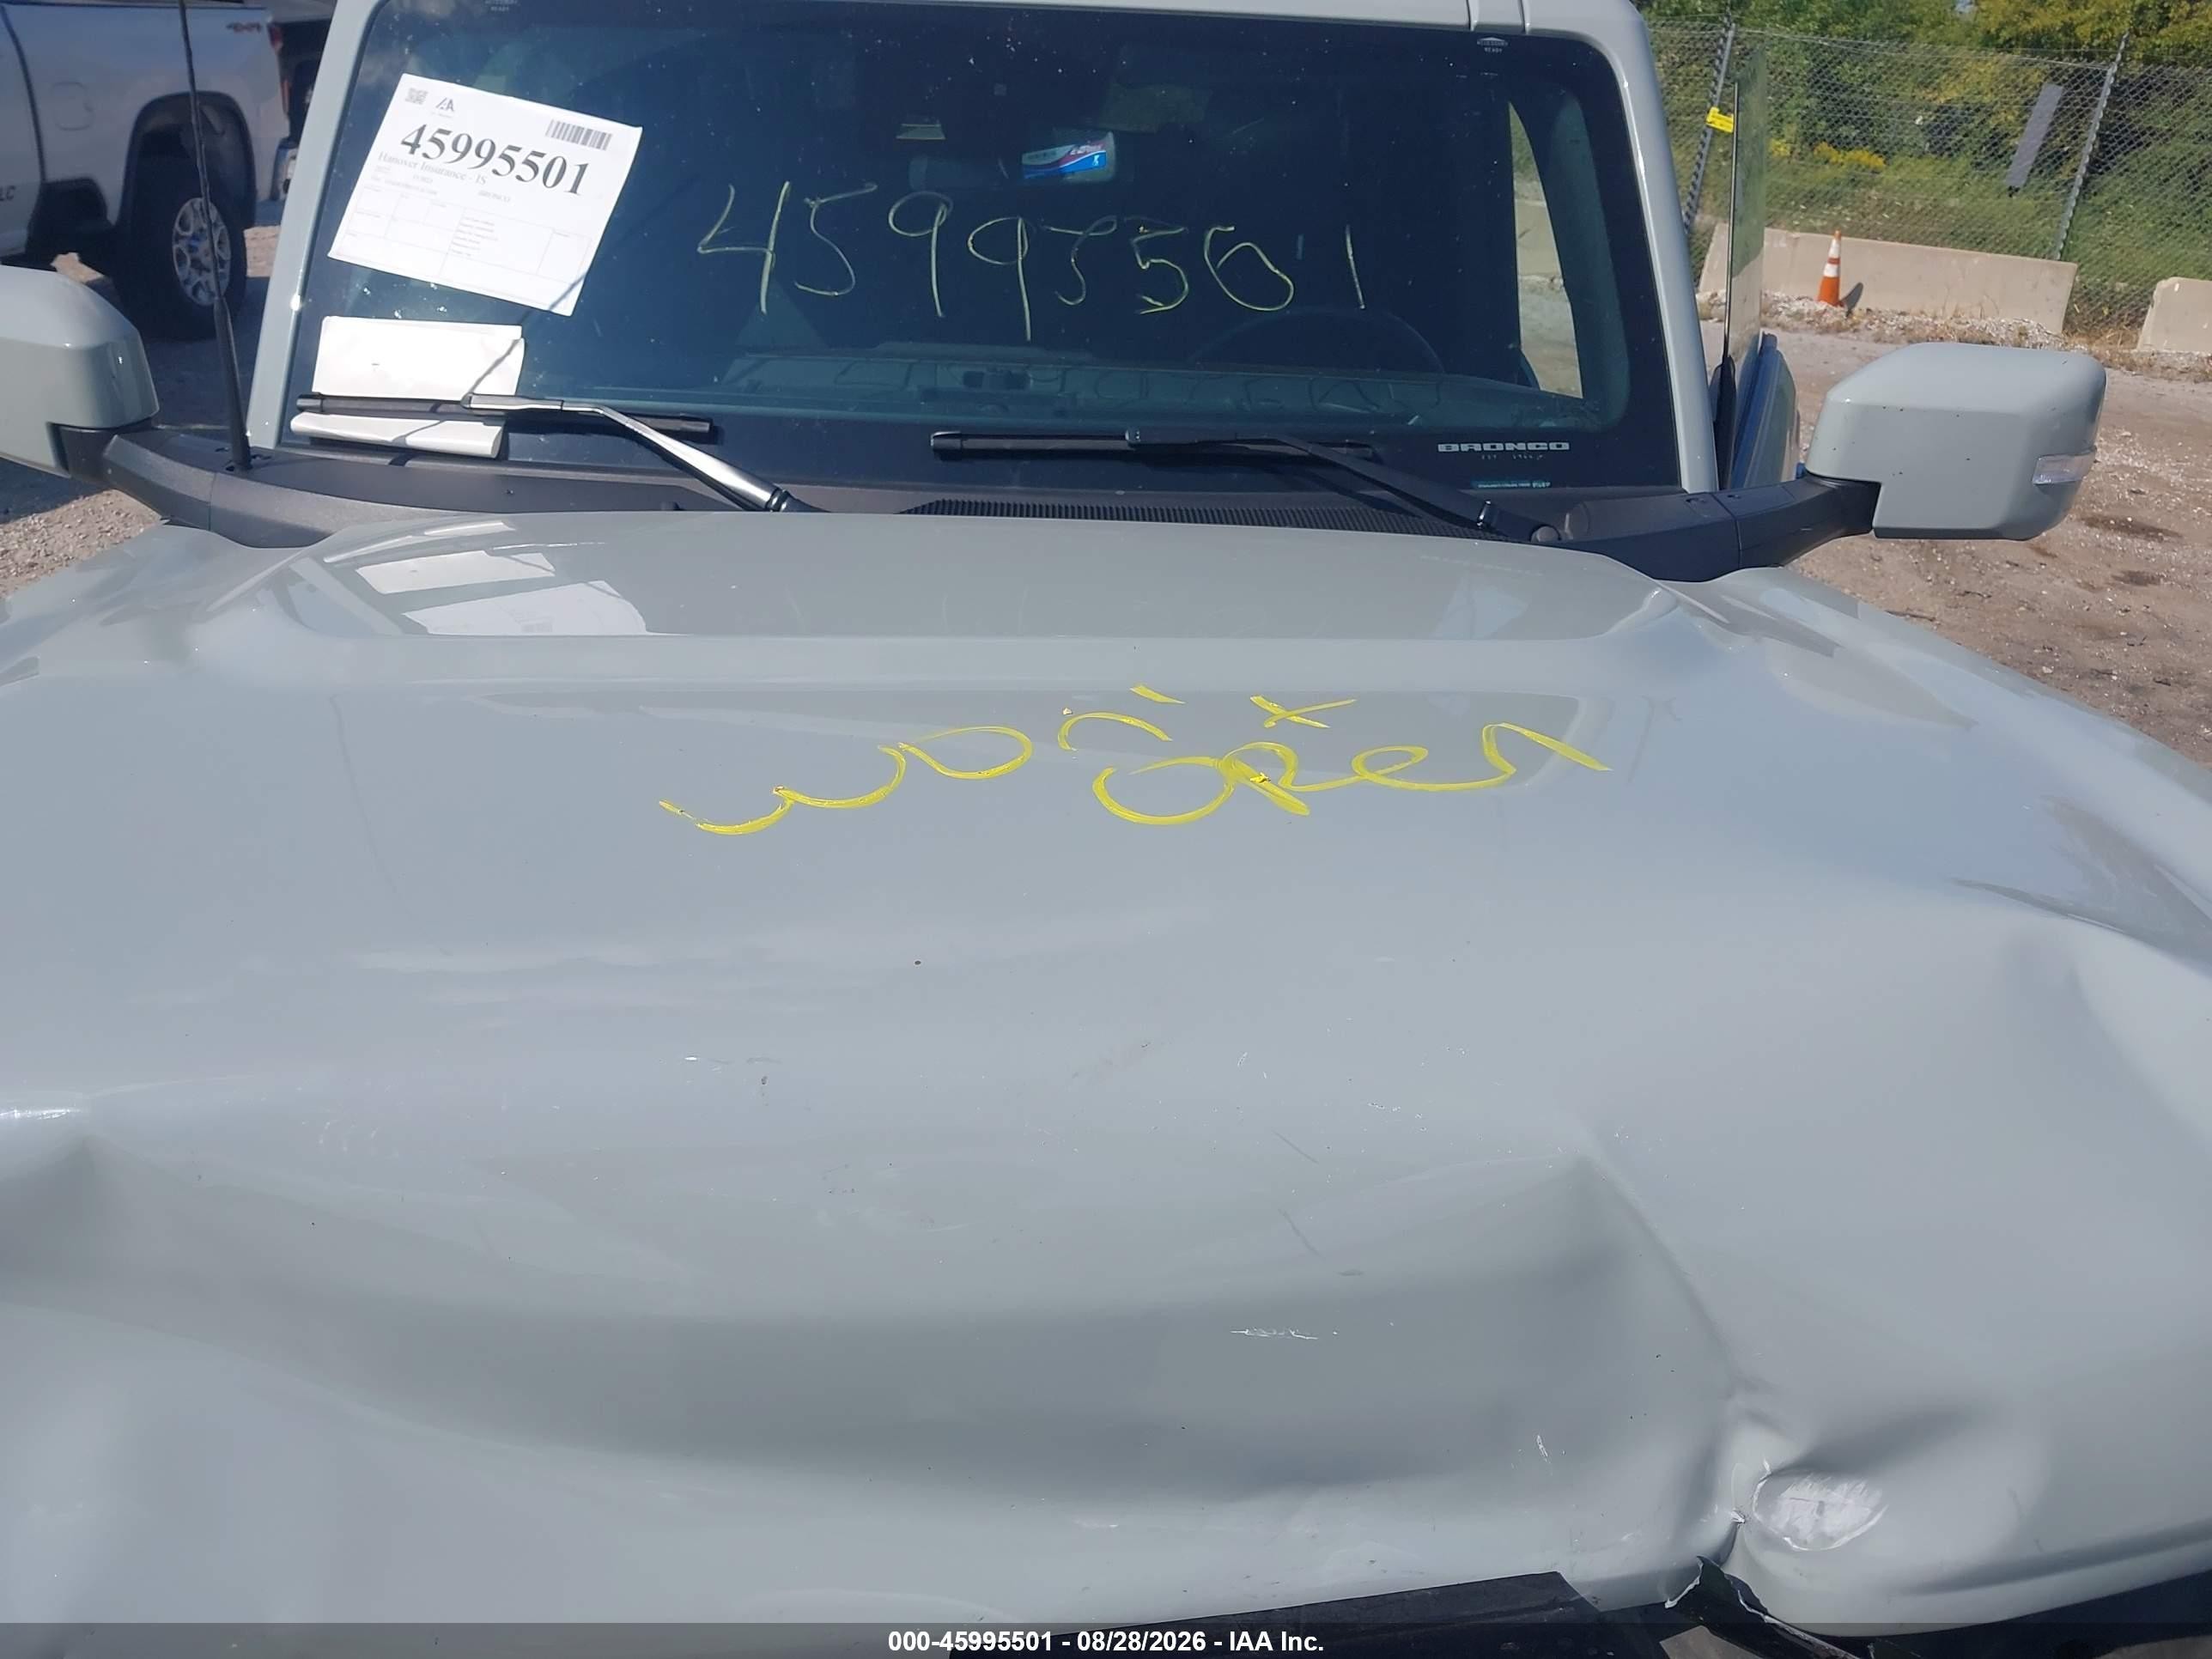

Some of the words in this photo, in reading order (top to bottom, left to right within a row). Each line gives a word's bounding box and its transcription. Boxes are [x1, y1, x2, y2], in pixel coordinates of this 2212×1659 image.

[377, 150, 419, 169] Hanover
[400, 123, 592, 196] 45995501
[696, 180, 1368, 342] 45995501
[1437, 441, 1571, 453] BRONCO
